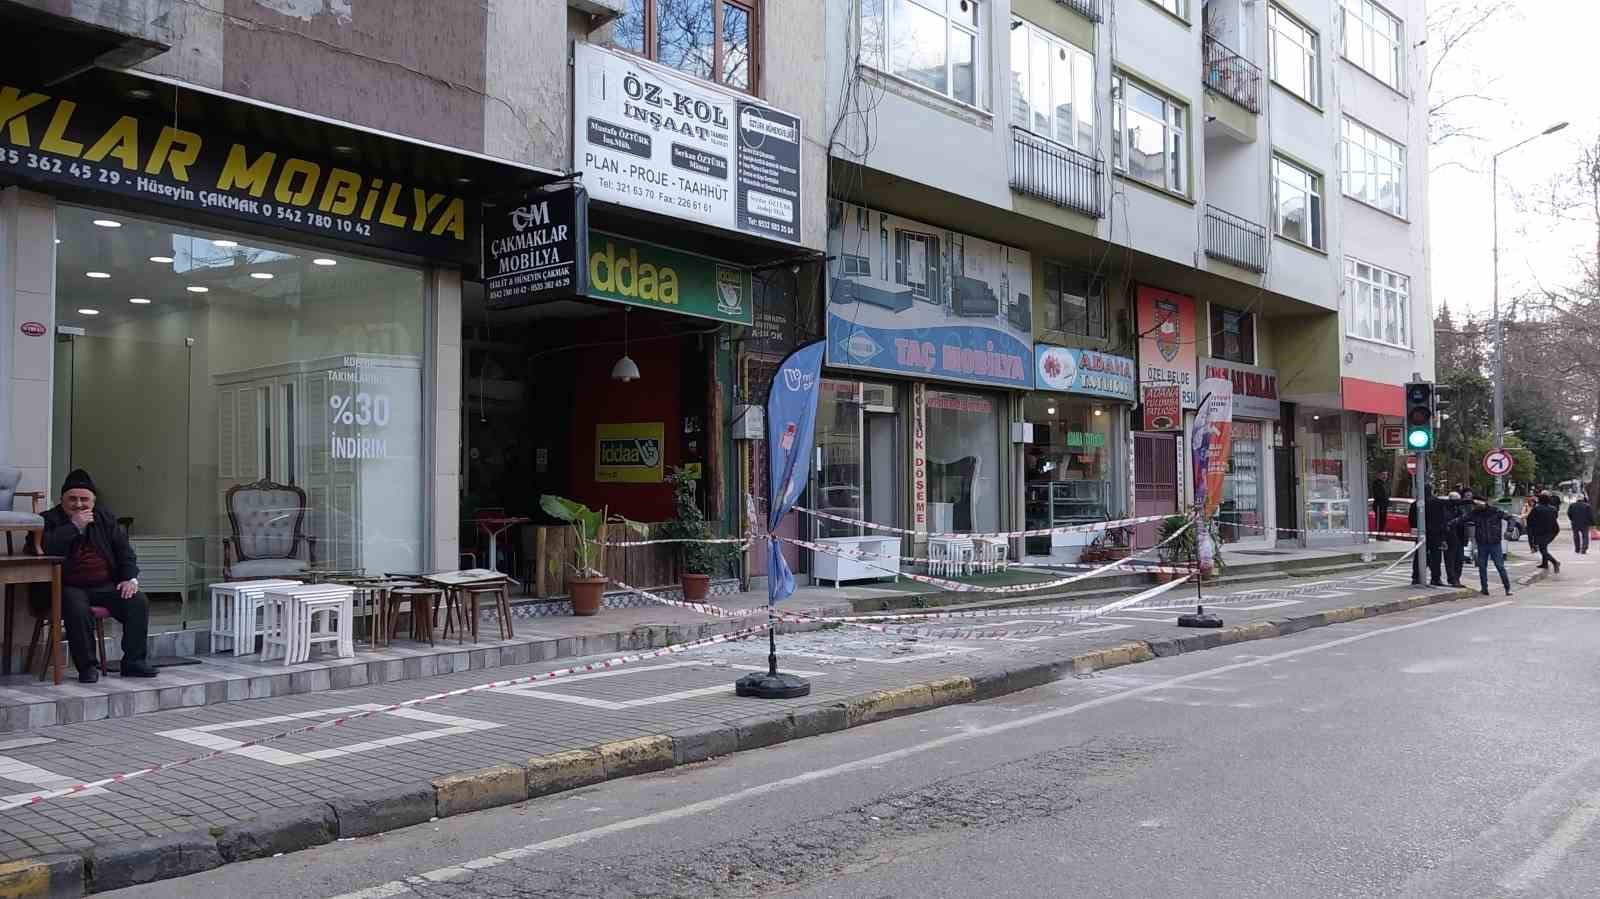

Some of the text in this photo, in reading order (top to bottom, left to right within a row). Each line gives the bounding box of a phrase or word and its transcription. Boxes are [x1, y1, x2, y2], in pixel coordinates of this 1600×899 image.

[623, 71, 729, 130] ÖZ-KOL
[0, 86, 202, 182] KLAR
[27, 153, 62, 174] 362
[69, 162, 92, 179] 45
[98, 168, 121, 185] 29
[136, 176, 194, 201] Hüseyin
[199, 189, 260, 216] ÇAKMAK
[277, 207, 302, 223] 542
[307, 212, 332, 229] 780
[336, 218, 352, 233] 10
[355, 222, 371, 237] 42
[585, 153, 619, 174] PLAN
[630, 164, 669, 187] PROJE
[678, 177, 729, 201] TAAHHÜT
[616, 182, 630, 193] 321
[659, 192, 676, 204] Fax:
[677, 196, 691, 208] 226
[491, 224, 568, 259] ÇAKMAKLAR
[498, 247, 560, 273] MOBİLYA
[330, 393, 390, 426] %30
